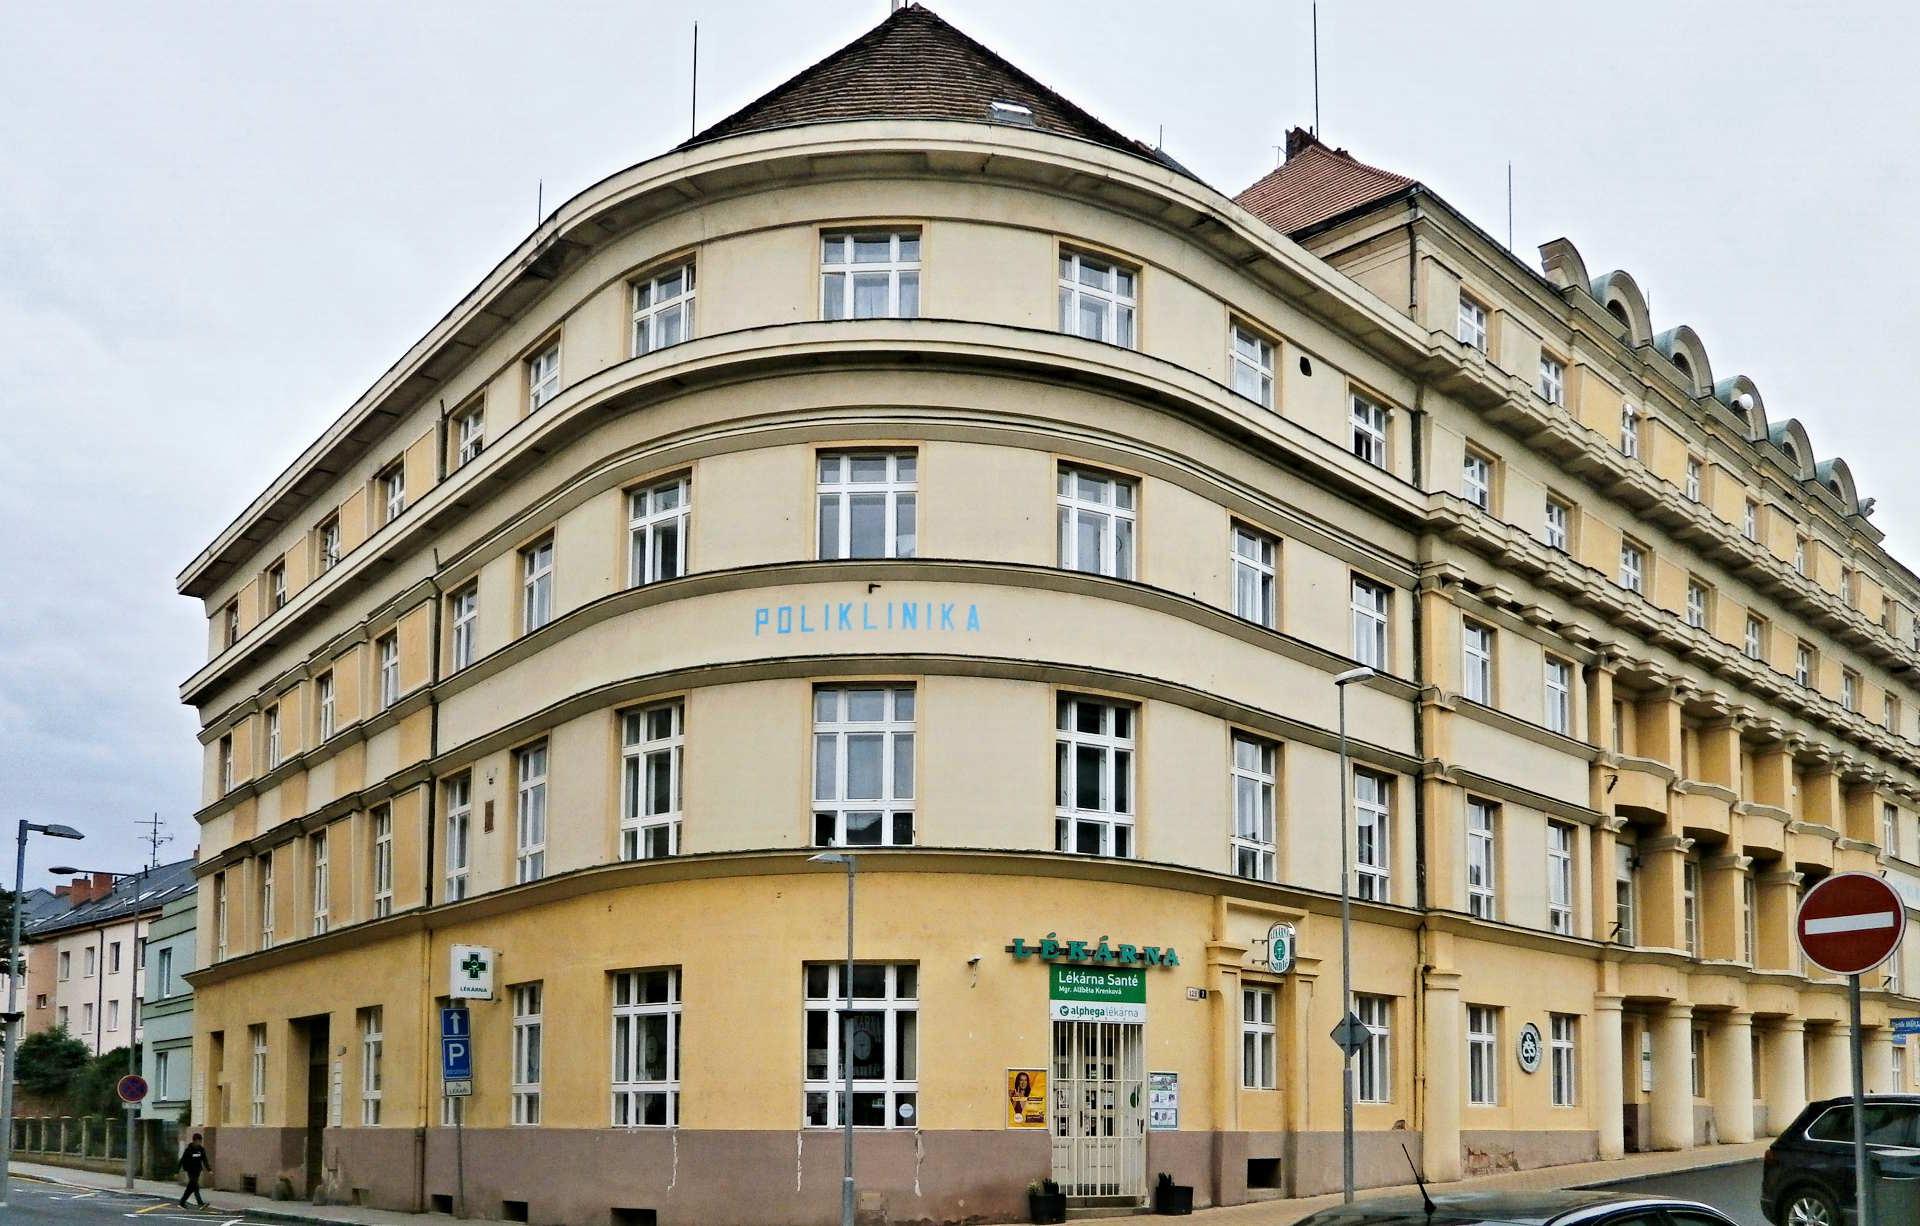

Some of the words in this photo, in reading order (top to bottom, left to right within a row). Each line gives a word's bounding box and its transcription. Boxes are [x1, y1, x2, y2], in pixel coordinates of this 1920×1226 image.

[755, 602, 981, 636] POLIKLINIKA
[1011, 931, 1180, 966] LÉKÁRNA
[1058, 970, 1105, 985] Lékárna
[1107, 973, 1139, 987] Santé
[1058, 985, 1072, 994] Mgr.
[1070, 1006, 1105, 1018] alphega
[1105, 1006, 1139, 1018] lékárna
[448, 1042, 466, 1067] P
